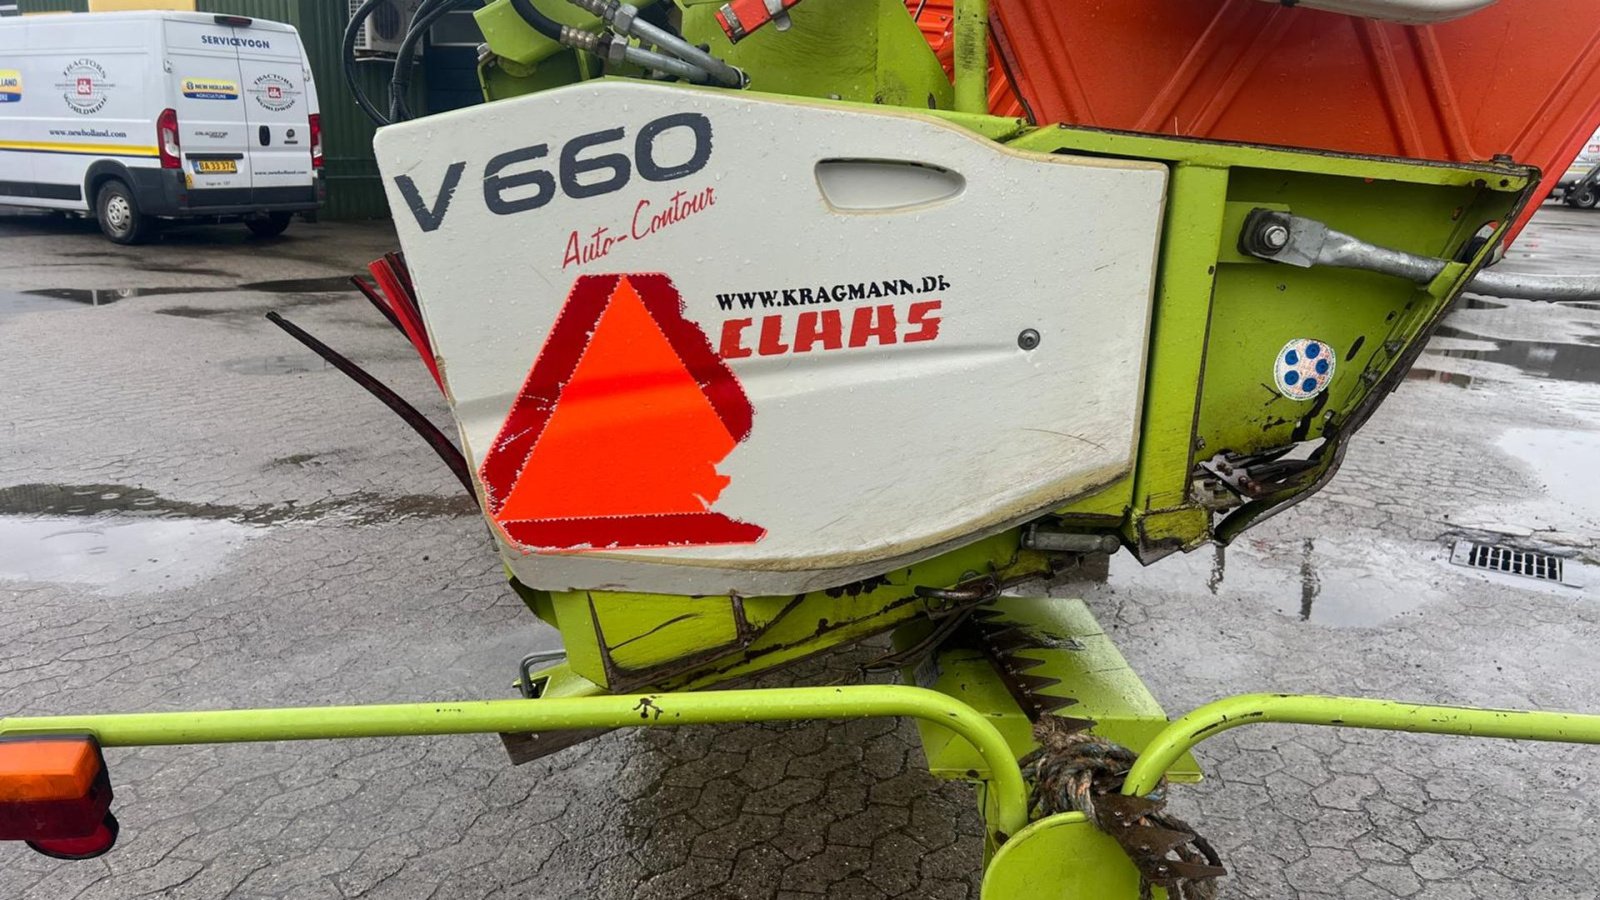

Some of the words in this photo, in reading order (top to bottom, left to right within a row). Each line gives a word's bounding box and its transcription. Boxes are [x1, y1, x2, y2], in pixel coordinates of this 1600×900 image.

[201, 34, 270, 49] SERVICEVOGN
[63, 58, 106, 79] TRACTORS
[254, 74, 293, 89] TRACTORS
[63, 93, 108, 115] WORLDWIDE
[256, 96, 296, 112] WORLDWIDE
[49, 128, 127, 138] www.newholland.com
[210, 161, 220, 170] 33
[394, 161, 466, 232] V
[482, 112, 713, 216] 660
[562, 185, 718, 270] Auto-Contour
[718, 300, 942, 359] CLAAS
